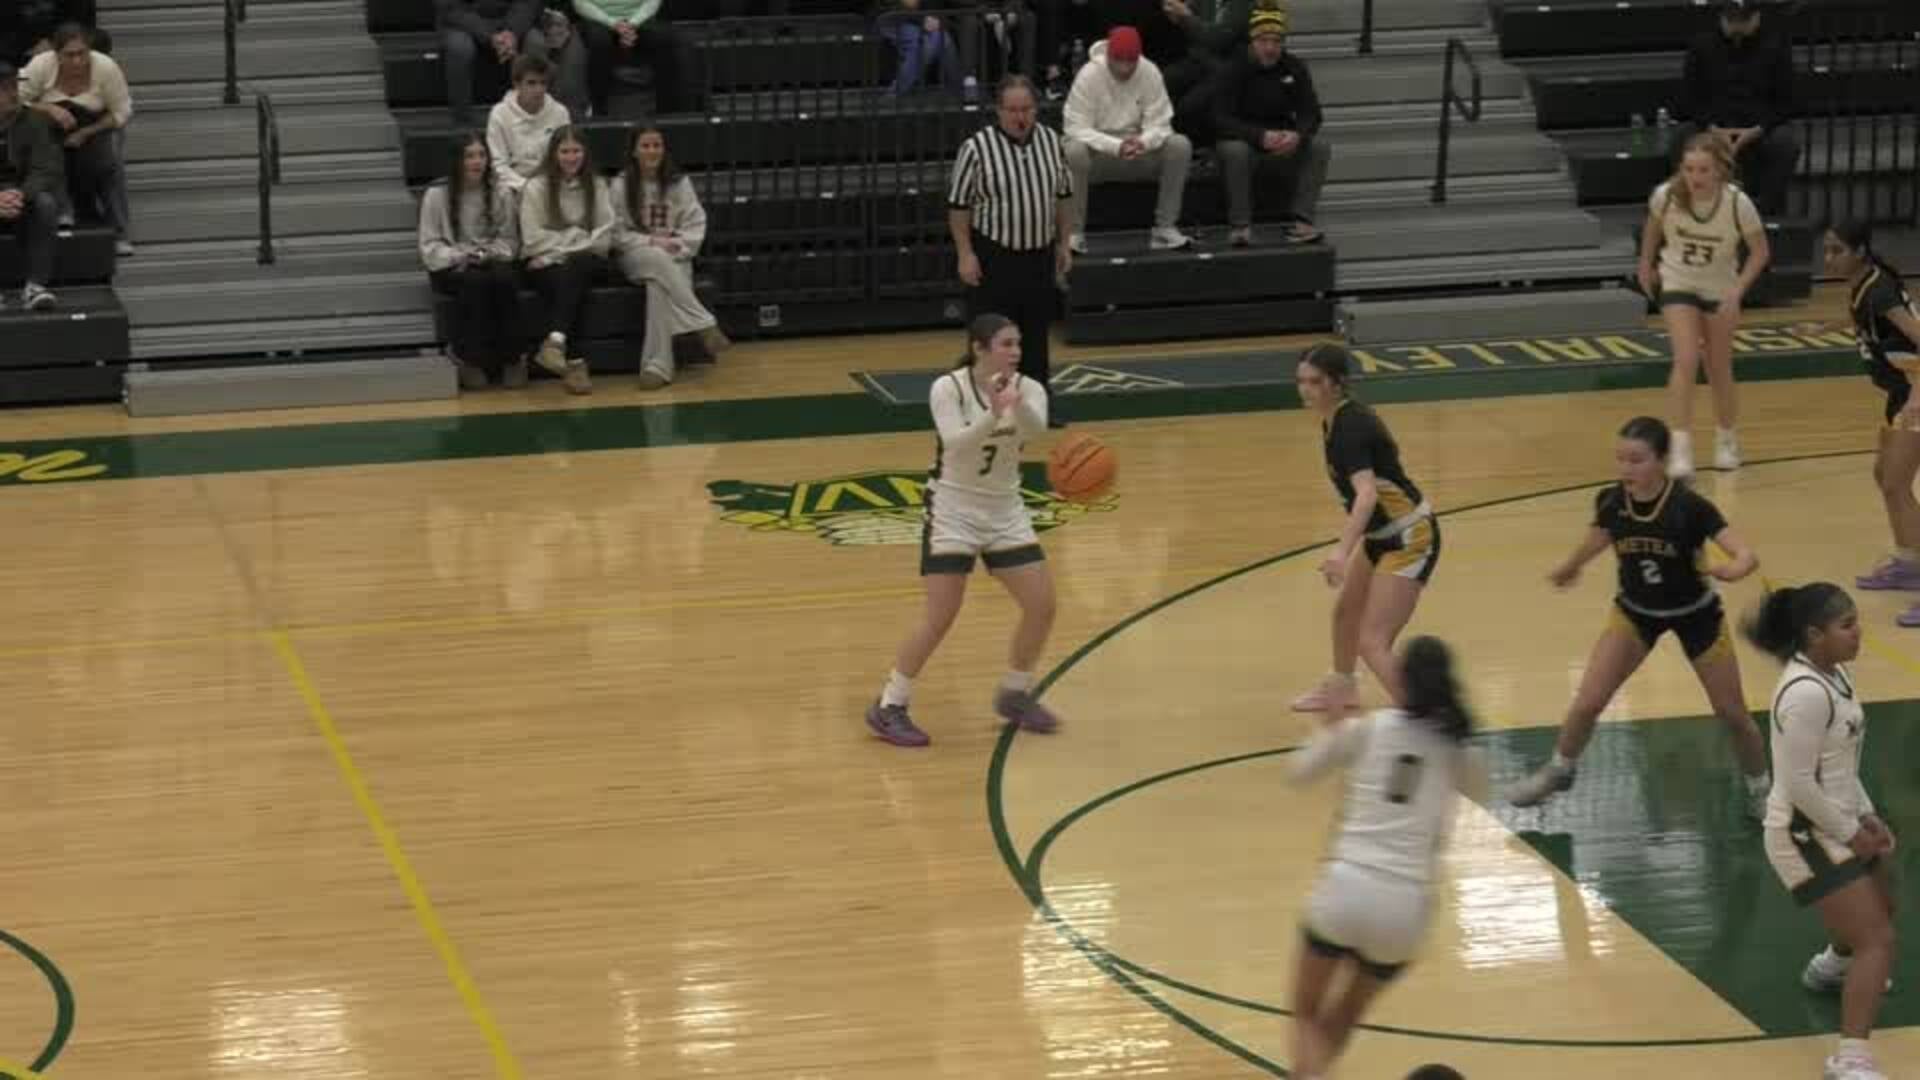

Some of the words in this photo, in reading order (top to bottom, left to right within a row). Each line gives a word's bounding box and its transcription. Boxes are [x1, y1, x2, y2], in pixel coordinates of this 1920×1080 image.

[1683, 242, 1713, 267] 23
[1351, 335, 1664, 373] VALLEY
[978, 444, 998, 476] 3
[1638, 559, 1662, 584] 2
